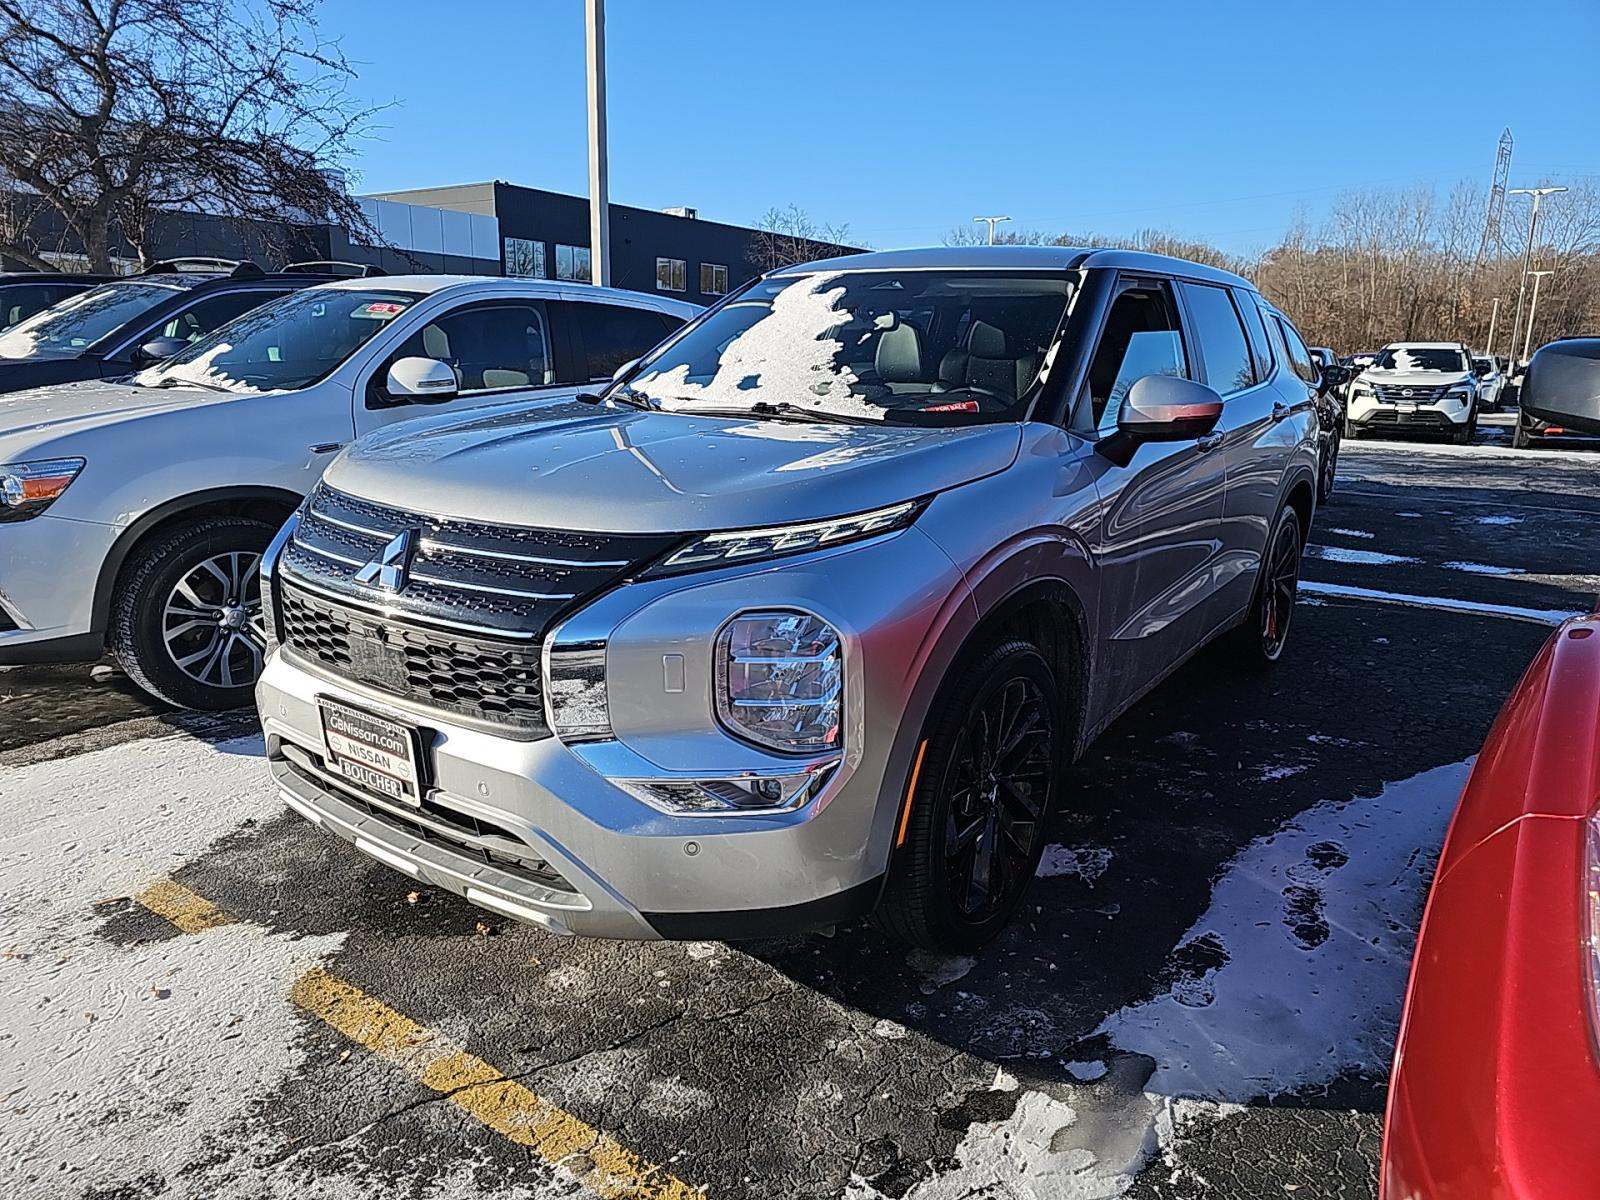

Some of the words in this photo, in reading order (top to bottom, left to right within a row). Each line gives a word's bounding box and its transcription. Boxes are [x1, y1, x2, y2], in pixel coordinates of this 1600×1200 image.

[330, 716, 403, 753] GBNissan.com
[348, 743, 391, 769] NISSAN
[344, 761, 398, 796] BOUCHER
